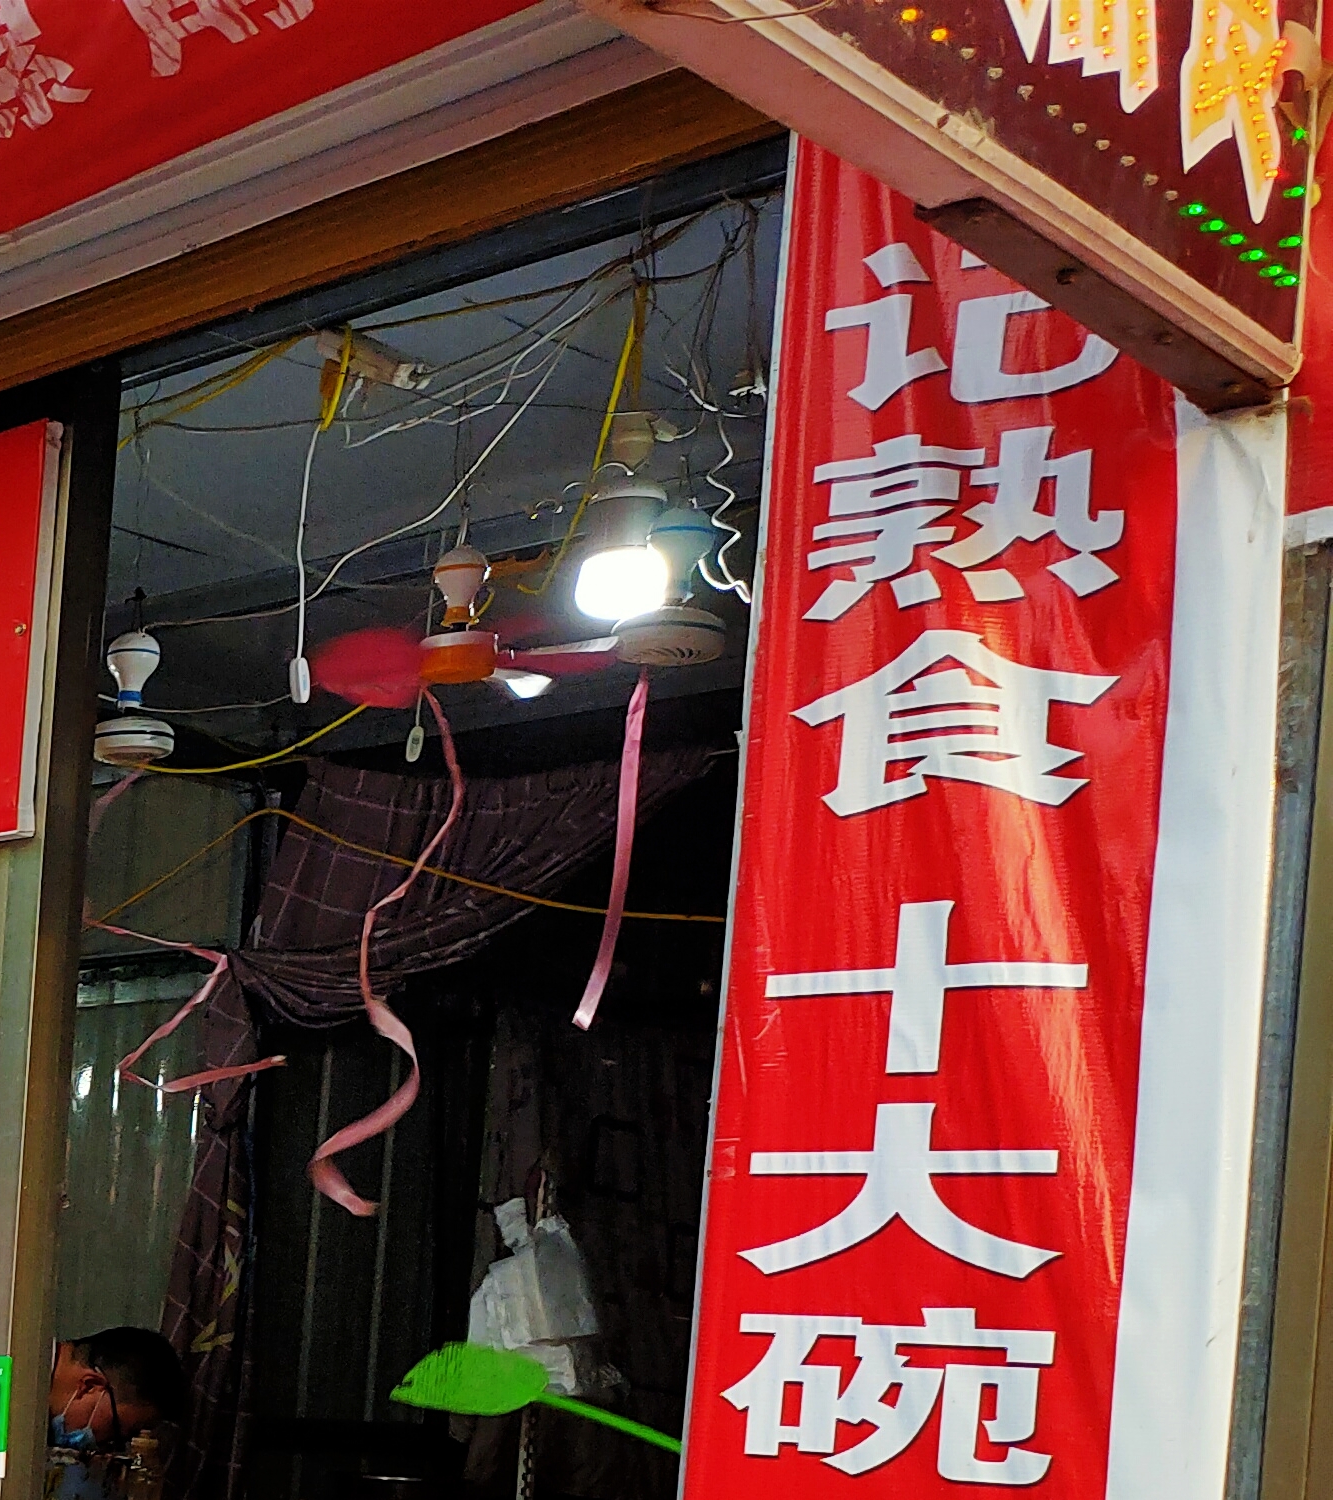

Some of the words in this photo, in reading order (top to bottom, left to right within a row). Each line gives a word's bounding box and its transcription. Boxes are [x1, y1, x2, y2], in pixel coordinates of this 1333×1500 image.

[795, 242, 1125, 816] 记熟食
[722, 899, 1089, 1487] 十大碗
